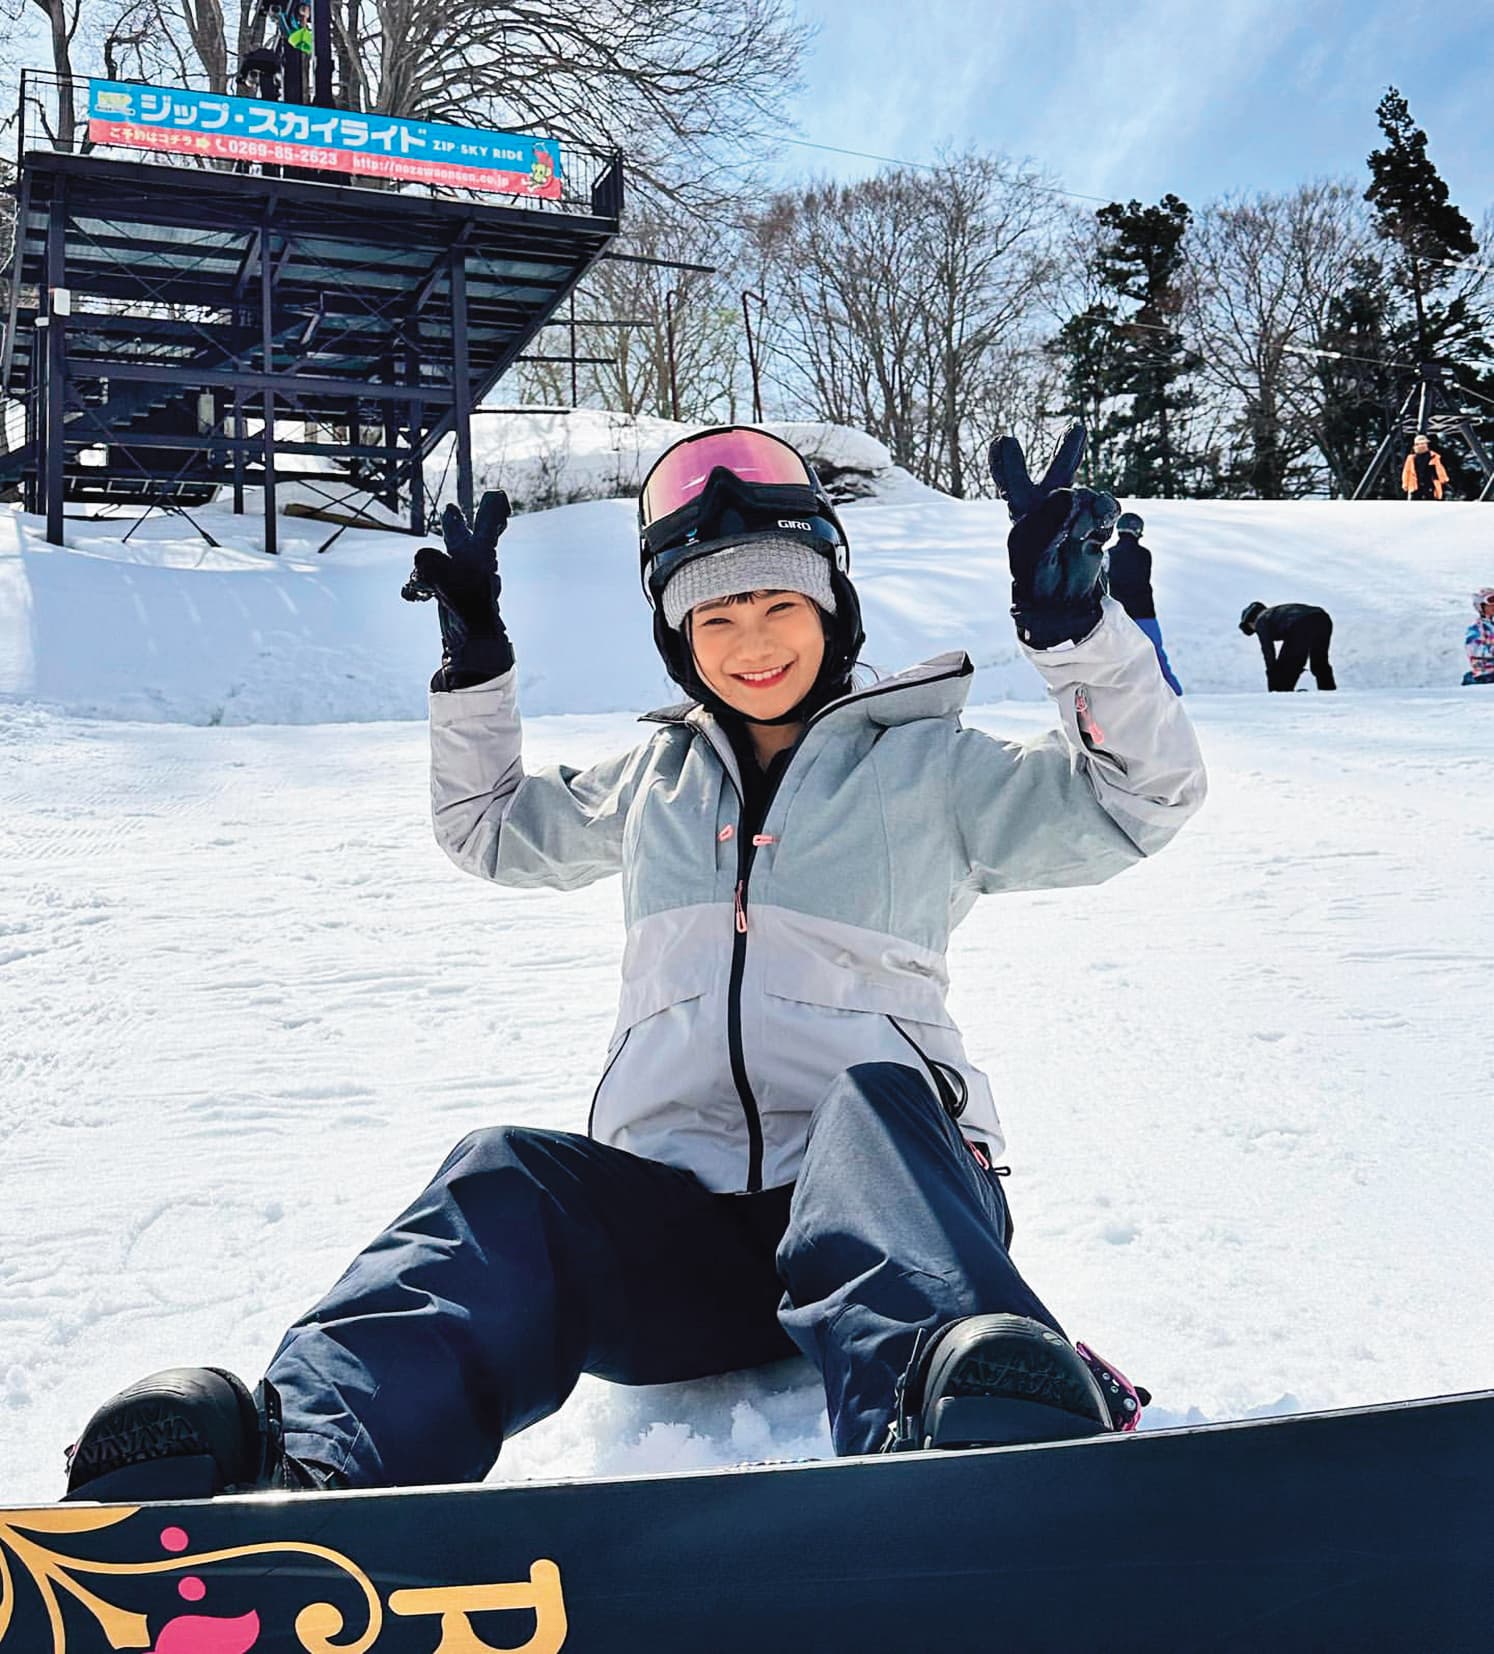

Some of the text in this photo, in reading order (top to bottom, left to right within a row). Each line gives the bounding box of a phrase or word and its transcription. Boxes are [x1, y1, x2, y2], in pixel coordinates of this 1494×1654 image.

[141, 94, 427, 153] ジップ・スカイライド
[109, 127, 192, 146] ご予約はコチラ
[228, 139, 337, 165] 0269-85-2623
[432, 139, 524, 161] ZIP SKY RIDE
[777, 519, 812, 531] GIRO
